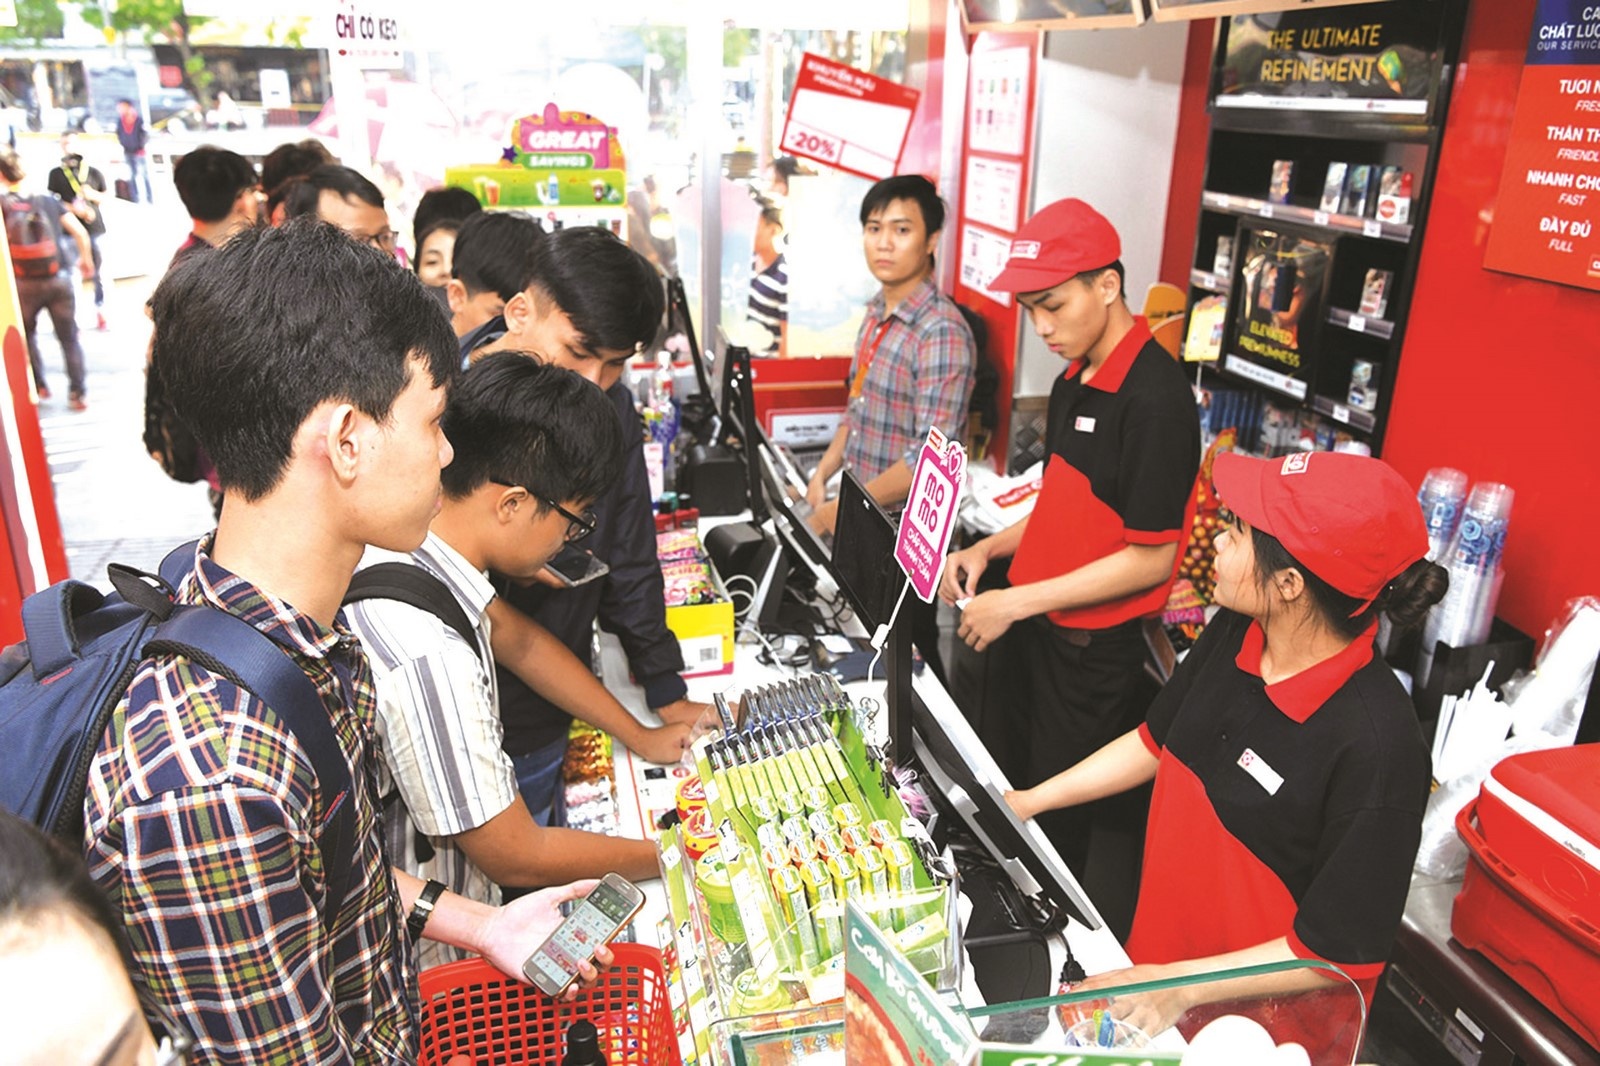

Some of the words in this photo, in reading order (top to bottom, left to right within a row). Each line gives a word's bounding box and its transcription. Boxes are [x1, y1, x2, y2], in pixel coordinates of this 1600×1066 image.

[1268, 29, 1296, 50] THE
[1301, 24, 1382, 49] ULTIMATE
[1537, 41, 1558, 51] OUR
[1260, 56, 1378, 82] REFINEMENT
[529, 129, 606, 150] GREAT
[529, 154, 587, 168] SAVINGS
[1526, 169, 1574, 188] NHANH
[1558, 193, 1587, 206] FAST
[1548, 238, 1574, 253] FULL
